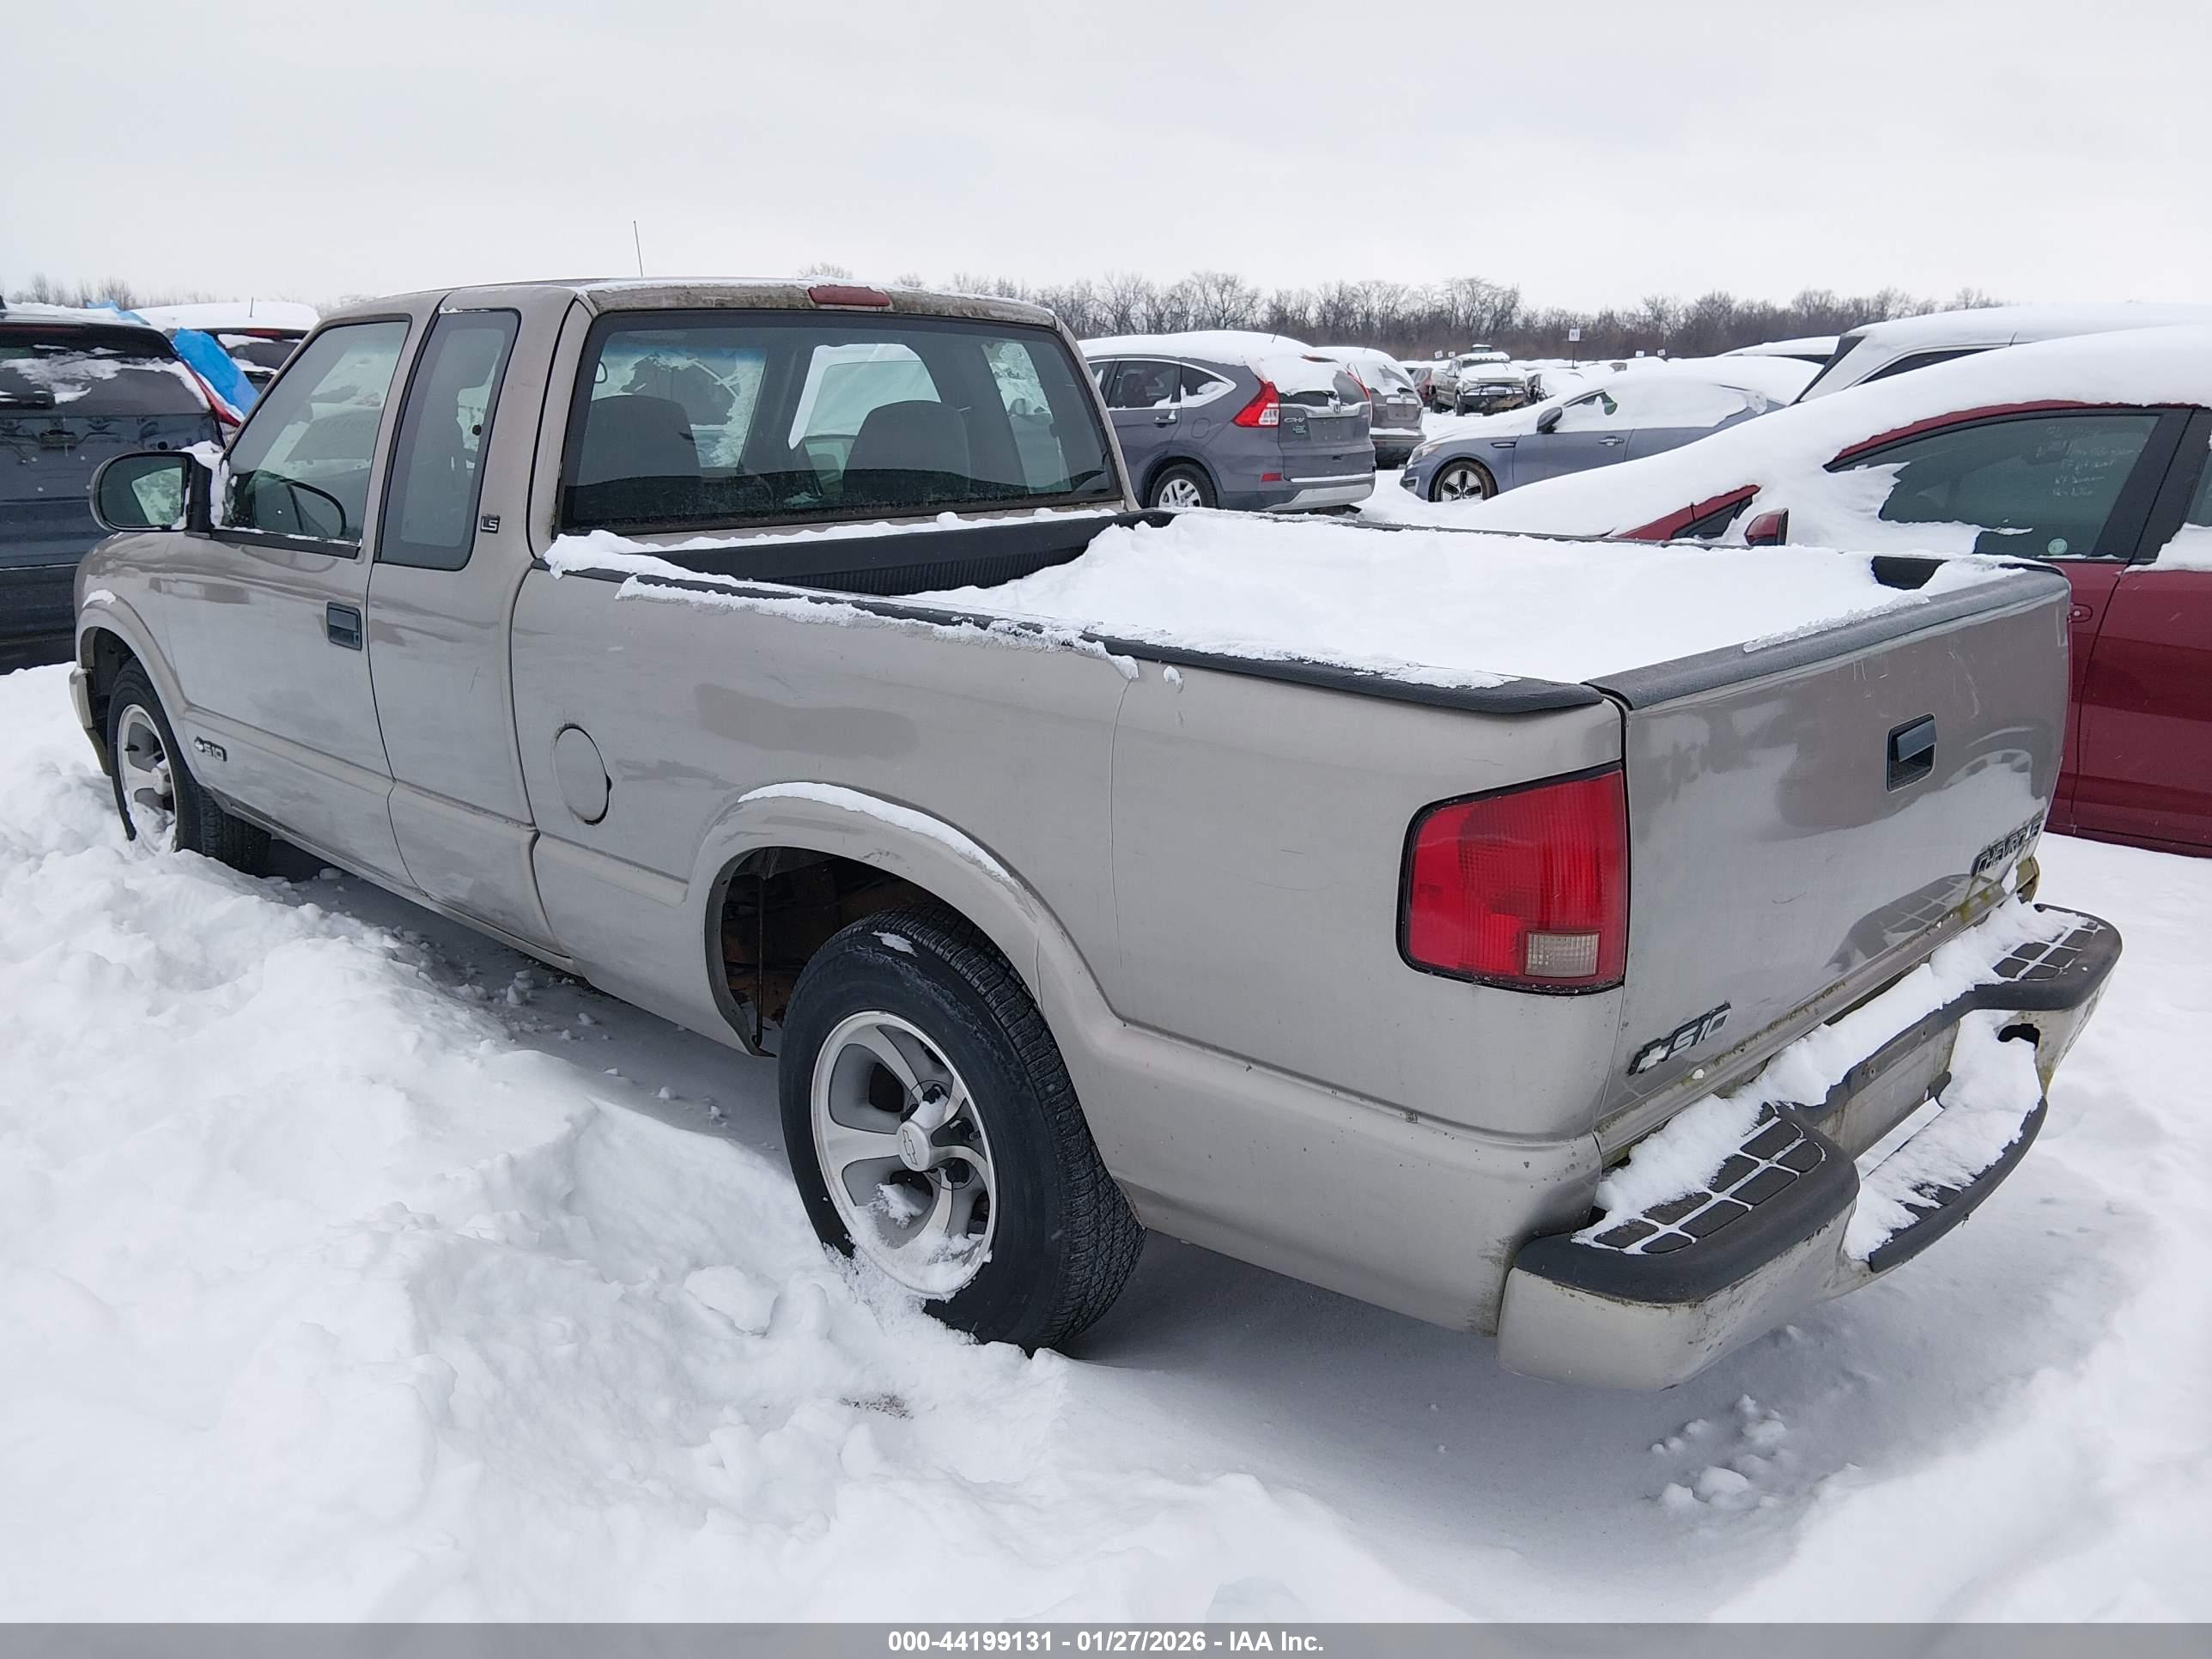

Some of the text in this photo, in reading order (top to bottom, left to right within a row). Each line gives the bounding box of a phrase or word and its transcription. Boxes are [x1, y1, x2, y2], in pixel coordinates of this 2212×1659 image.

[481, 517, 499, 532] LS
[203, 741, 225, 762] S10
[1972, 809, 2045, 877] CHEVROE
[1667, 1006, 1732, 1061] S10
